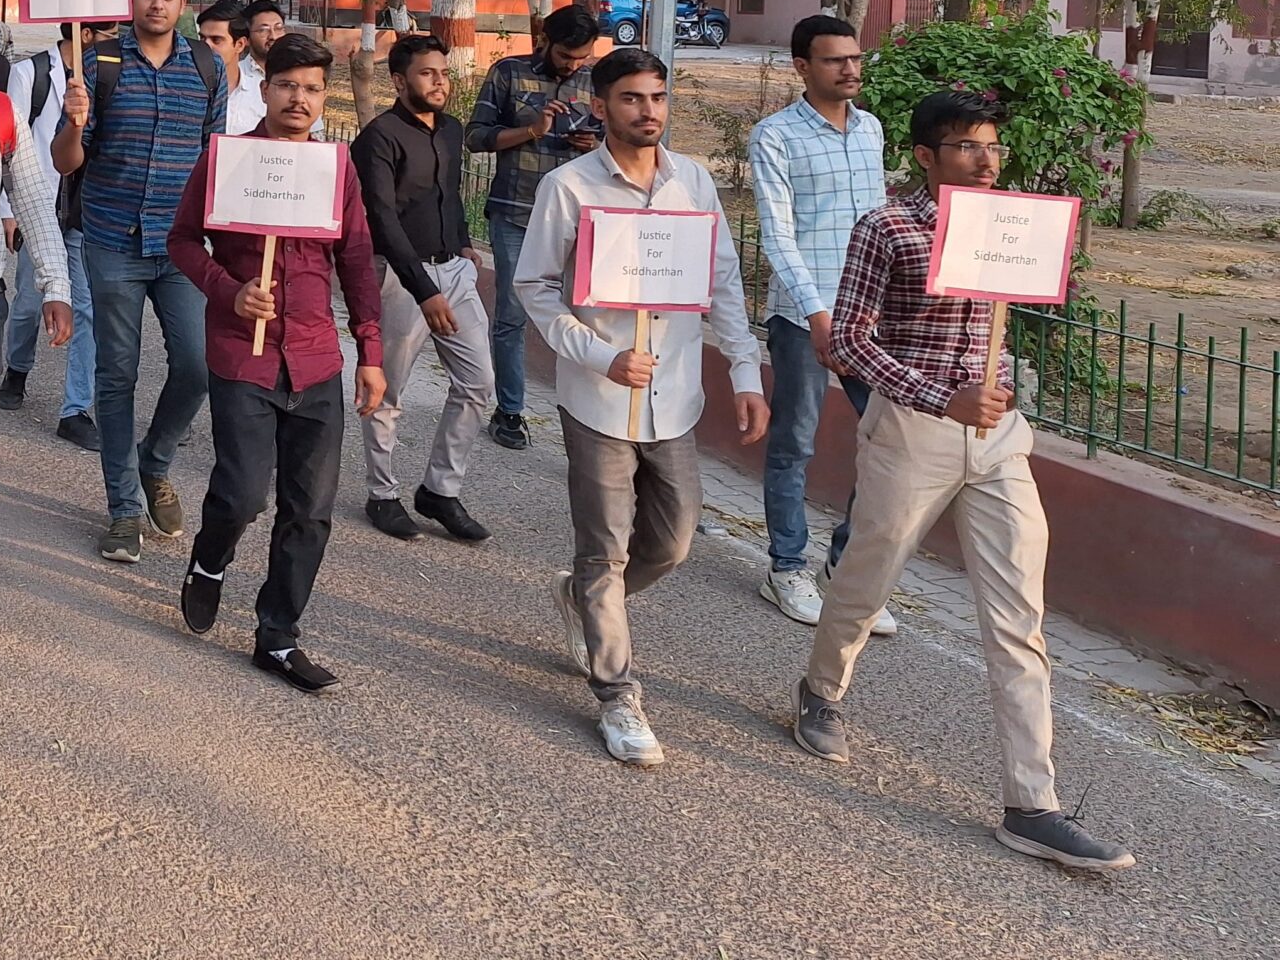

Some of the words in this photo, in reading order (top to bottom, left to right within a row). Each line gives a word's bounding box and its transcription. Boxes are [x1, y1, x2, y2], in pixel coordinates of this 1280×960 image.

[259, 154, 294, 166] Justice
[267, 172, 284, 182] For
[243, 187, 306, 201] Siddharthan
[993, 212, 1030, 226] Justice
[638, 230, 672, 241] Justice
[1001, 233, 1019, 244] For
[647, 248, 664, 258] For
[973, 249, 1038, 266] Siddharthan
[622, 265, 684, 277] Siddharthan
